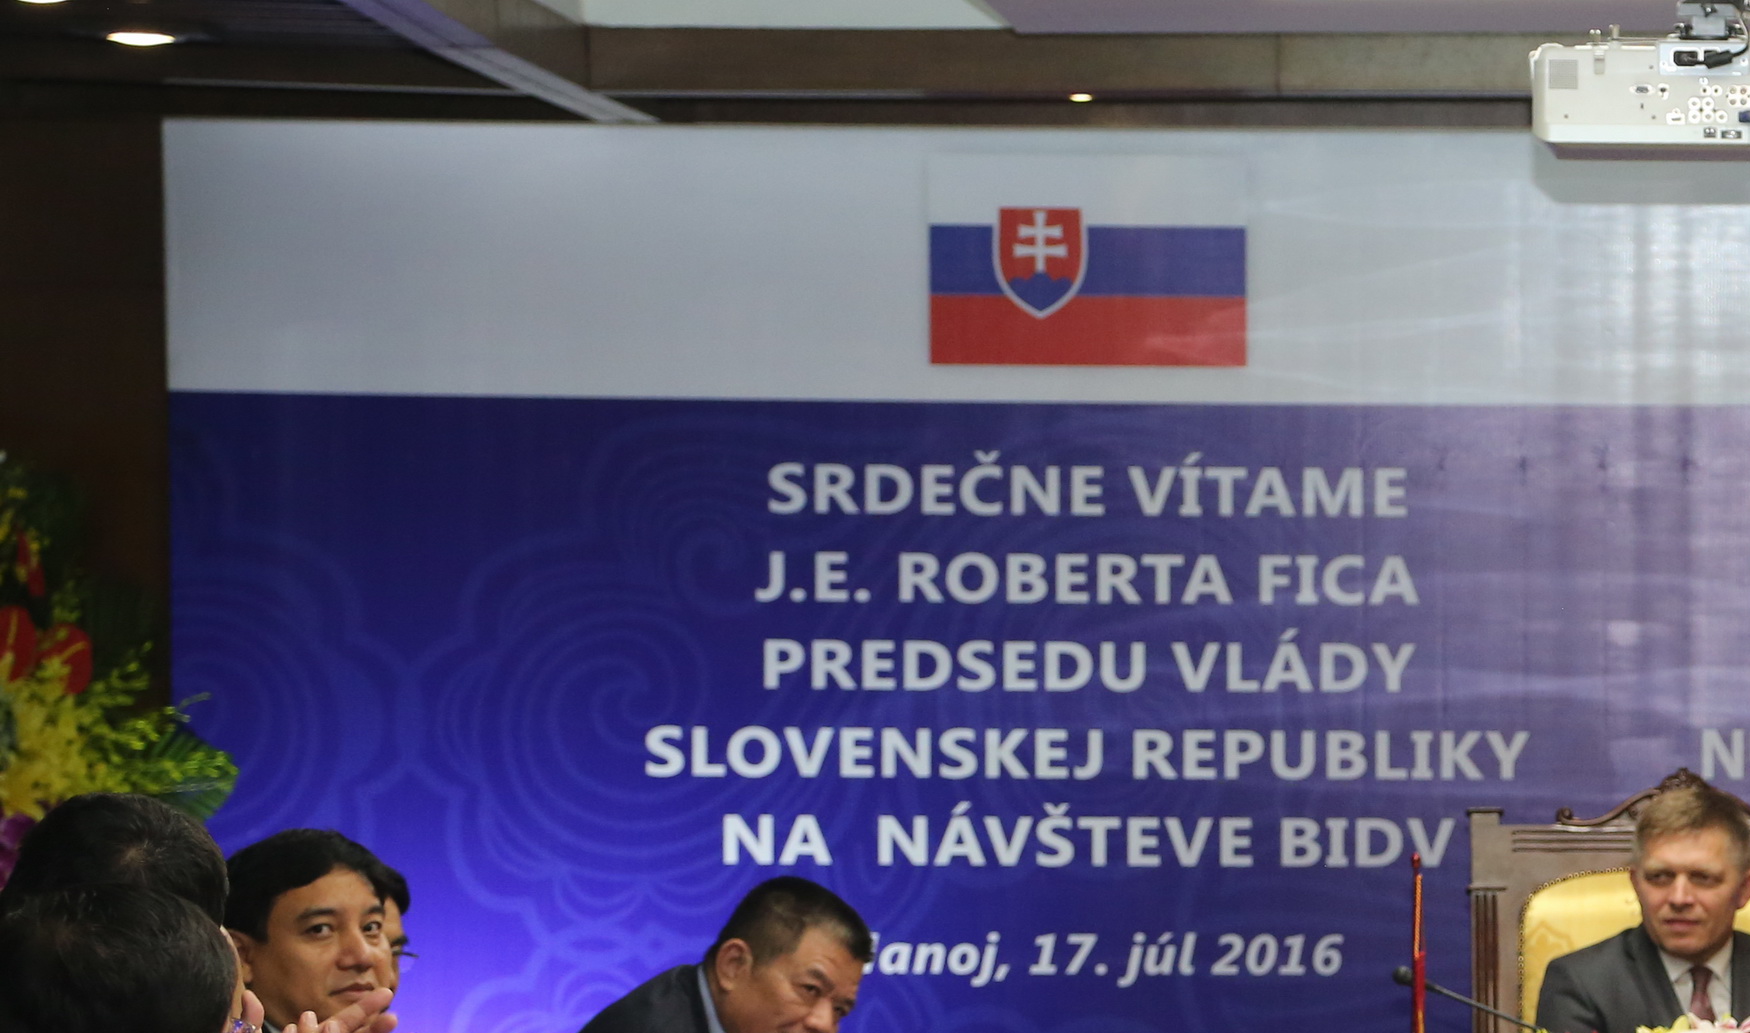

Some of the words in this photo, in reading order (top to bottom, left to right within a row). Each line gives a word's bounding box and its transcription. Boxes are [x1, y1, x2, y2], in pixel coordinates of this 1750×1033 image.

[767, 450, 1106, 517] SRDEČNE
[1128, 452, 1407, 517] VÍTAME
[754, 550, 872, 604] J.E.
[898, 551, 1233, 605] ROBERTA
[1259, 554, 1419, 606] FICA
[762, 637, 1147, 693] PREDSEDU
[1171, 628, 1415, 693] VLÁDY
[644, 724, 1104, 781] SLOVENSKEJ
[1132, 728, 1528, 782] REPUBLIKY
[721, 812, 834, 867] NA
[876, 800, 1254, 868] NÁVŠTEVE
[1279, 816, 1455, 869] BIDV
[1028, 932, 1108, 976] 17.
[1116, 930, 1201, 988] júl
[1209, 932, 1345, 977] 2016
